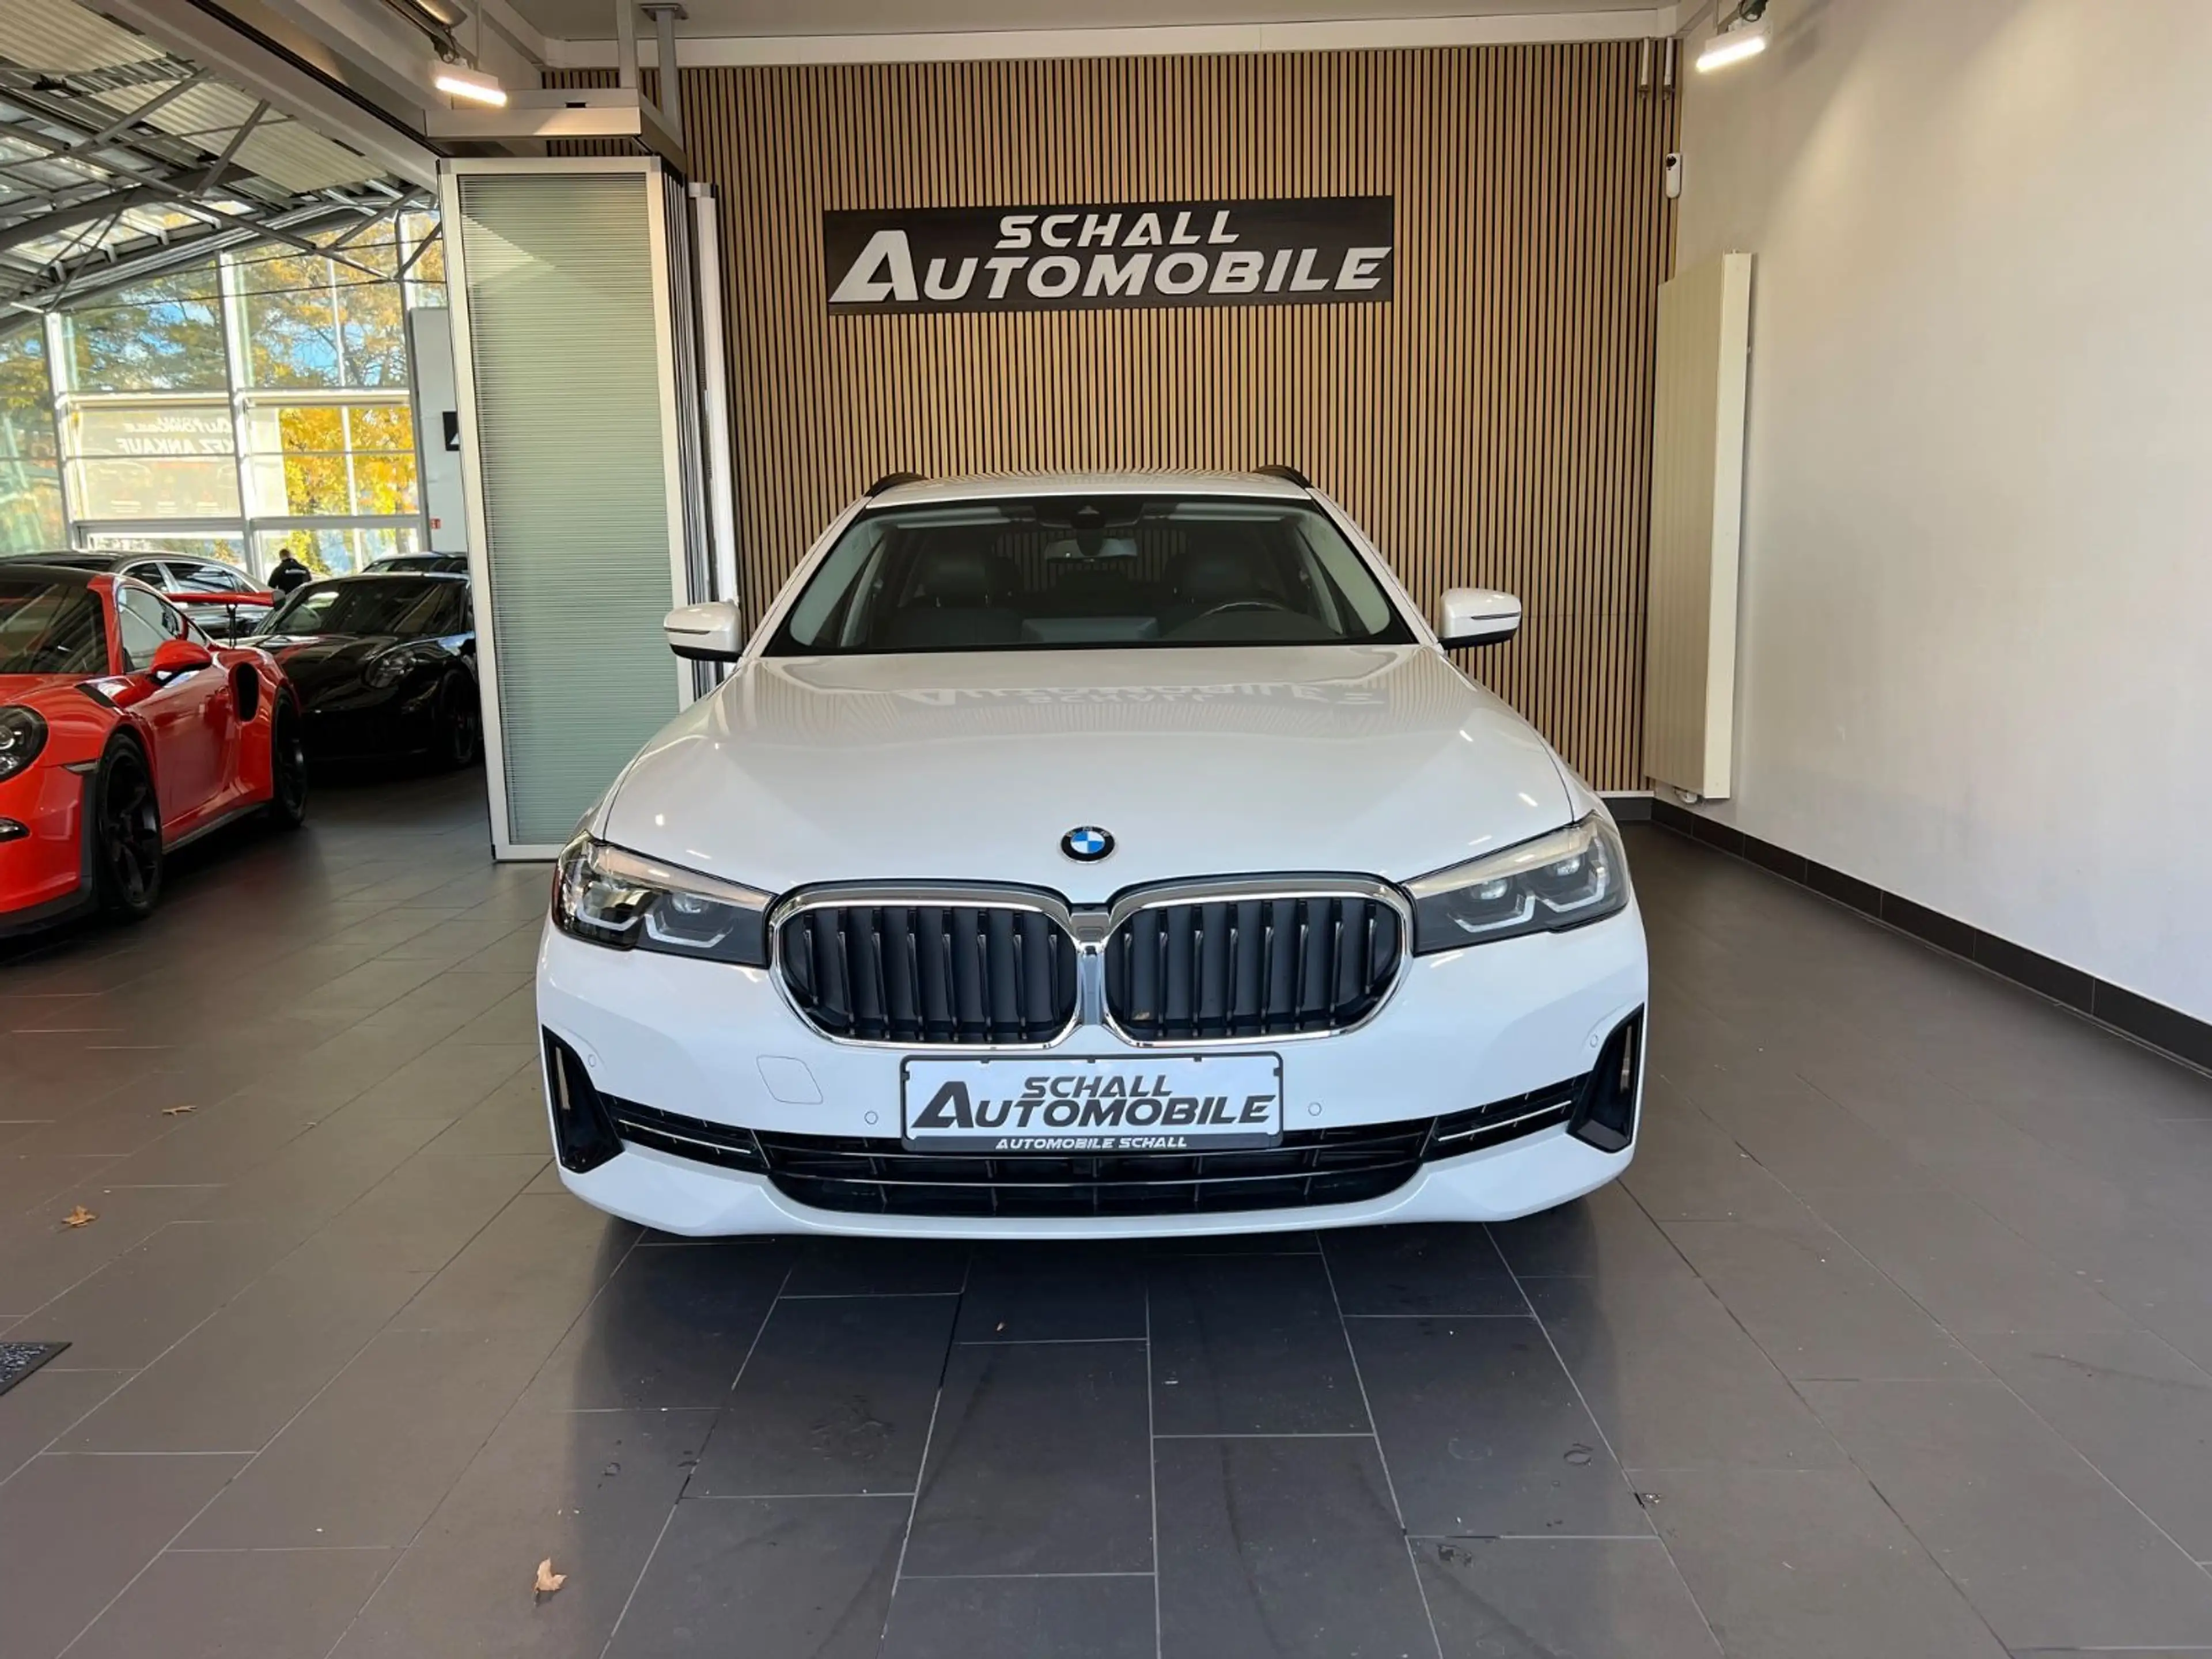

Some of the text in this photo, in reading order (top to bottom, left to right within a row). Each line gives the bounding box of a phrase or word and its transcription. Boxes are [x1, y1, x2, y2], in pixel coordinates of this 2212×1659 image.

[994, 210, 1240, 249] SCHALL
[828, 229, 1392, 303] AUTOMOBILE
[911, 1081, 1277, 1128] AUTOMOBILE
[1020, 1075, 1173, 1099] SCHALL
[995, 1137, 1187, 1150] AUTOMOBILE SCHALL
